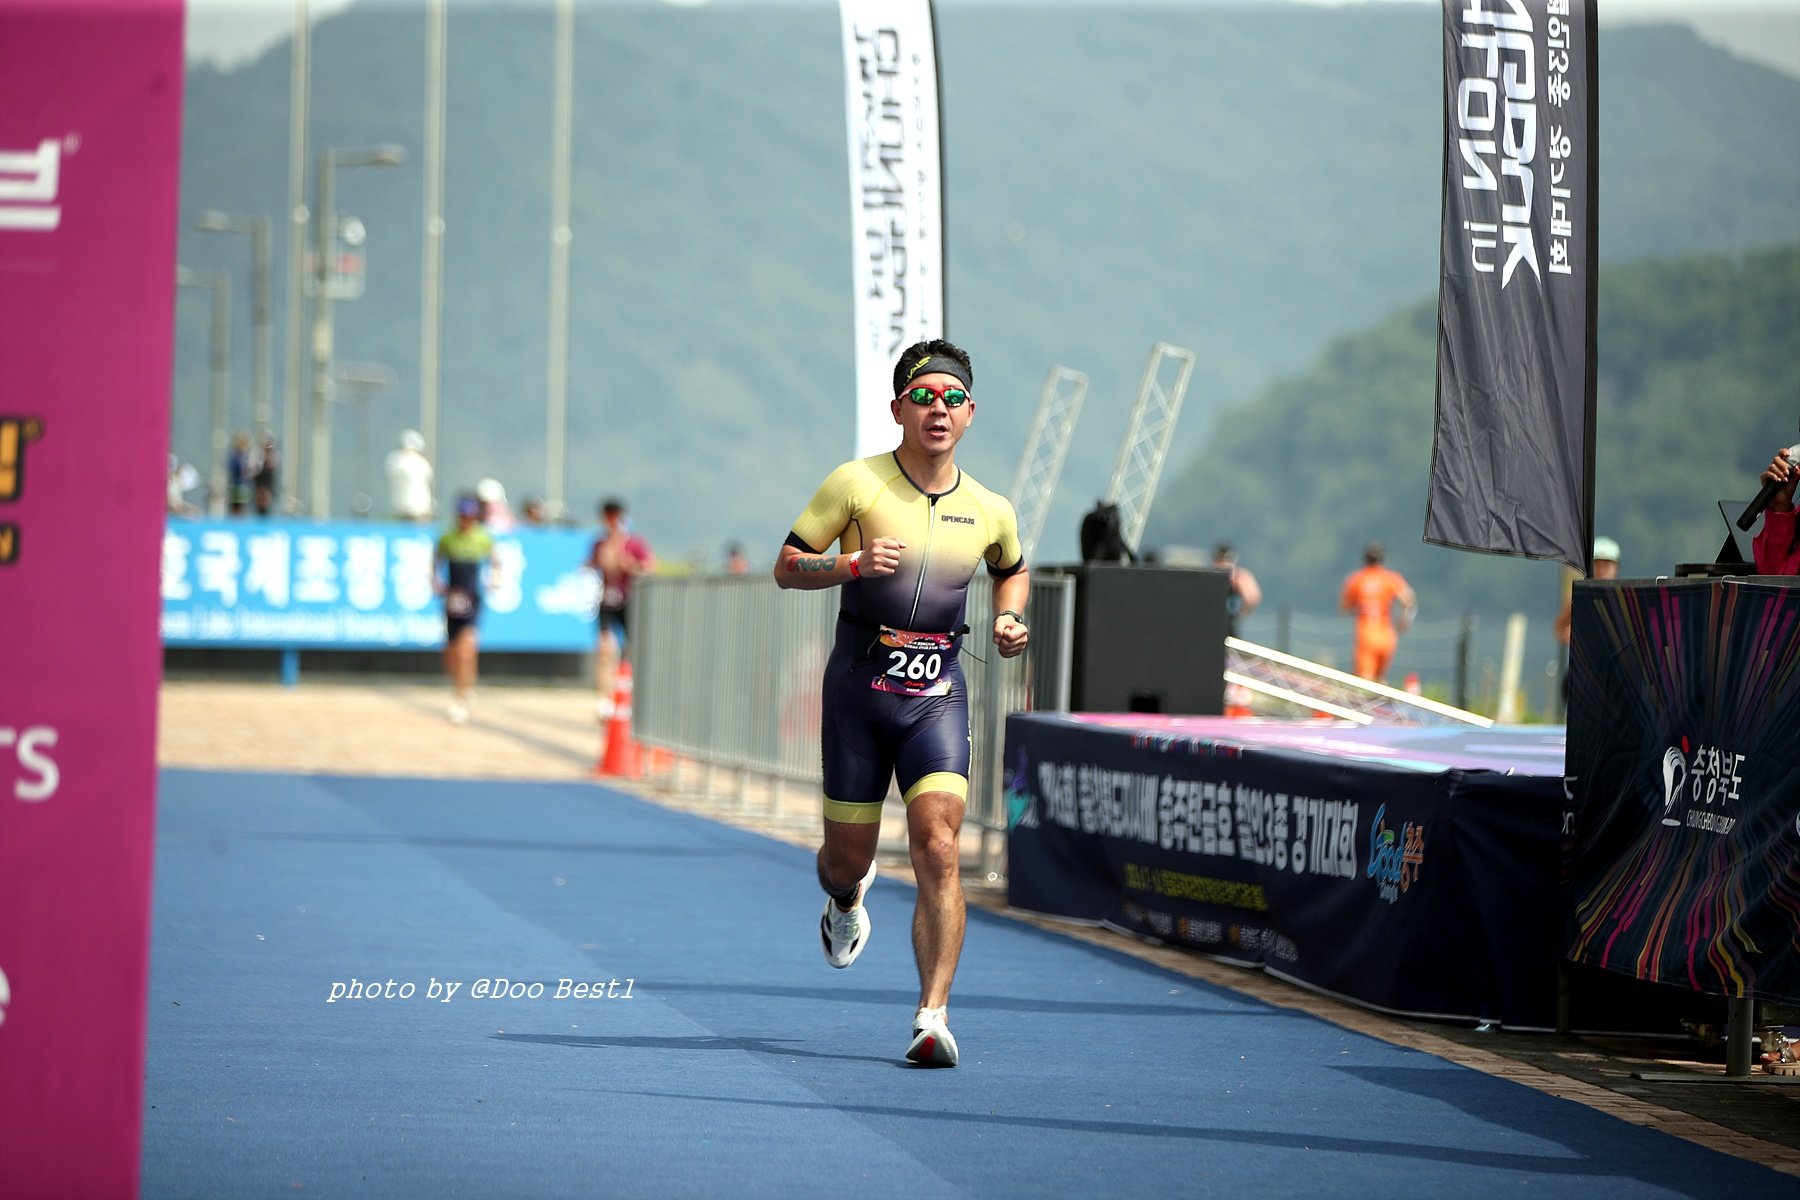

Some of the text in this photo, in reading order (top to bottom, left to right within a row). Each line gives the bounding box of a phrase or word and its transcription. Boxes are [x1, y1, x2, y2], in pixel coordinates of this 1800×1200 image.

[886, 650, 942, 680] 260
[1690, 744, 1746, 807] 충청북도
[1159, 774, 1236, 857] 충주탄금호
[1290, 795, 1360, 881] 경기대회
